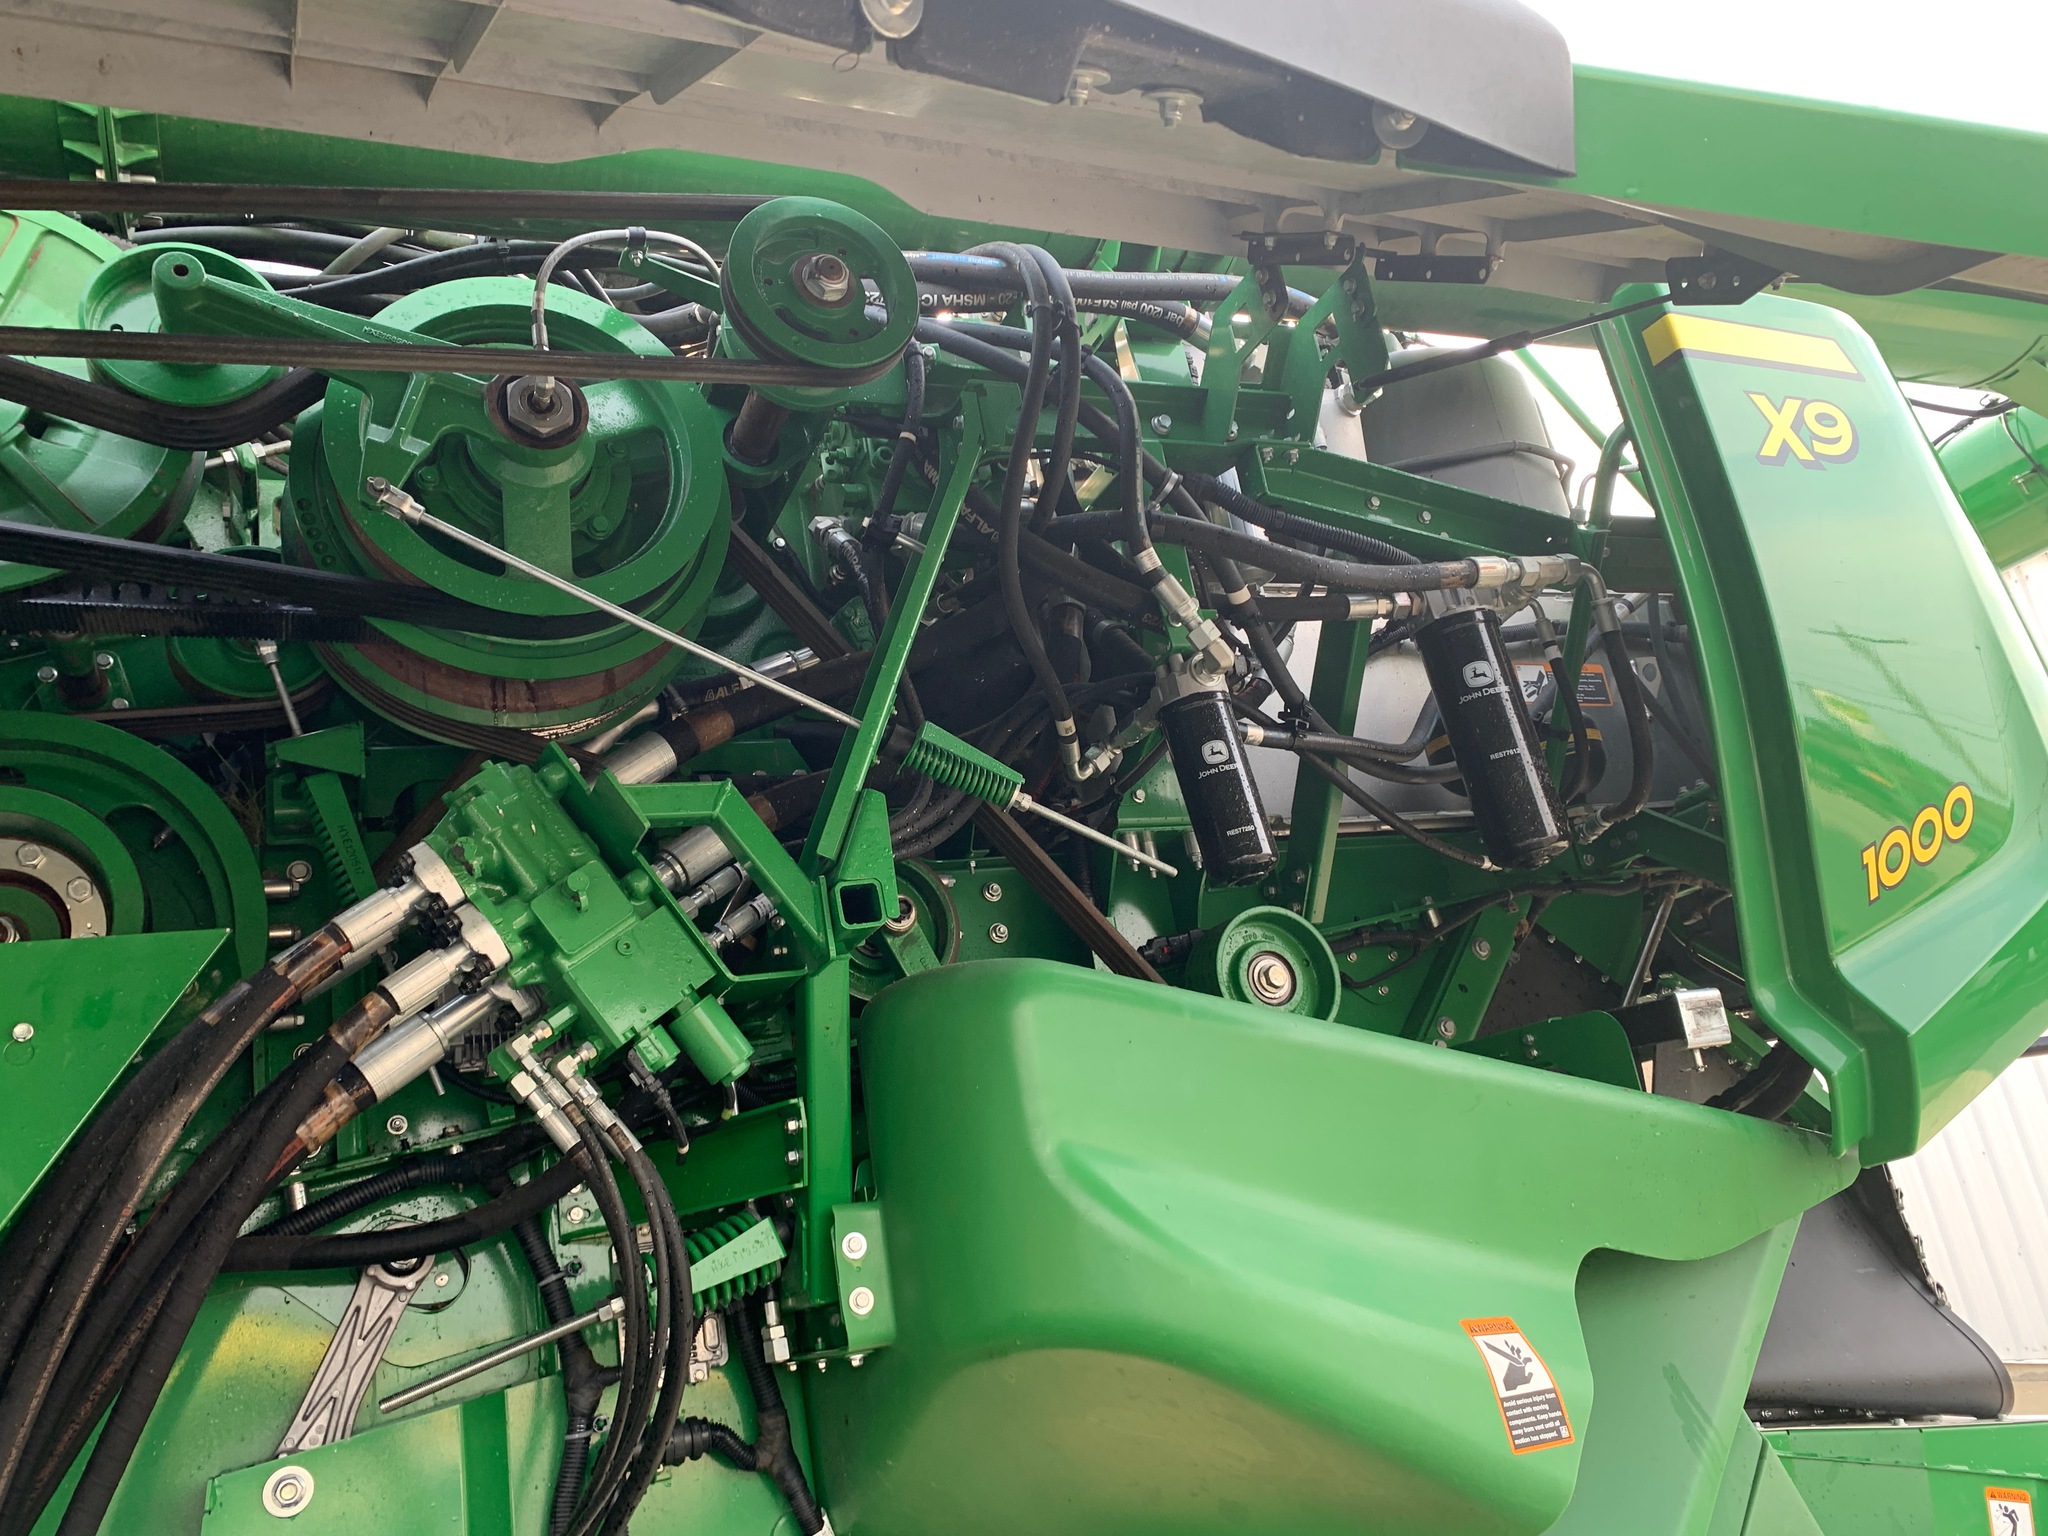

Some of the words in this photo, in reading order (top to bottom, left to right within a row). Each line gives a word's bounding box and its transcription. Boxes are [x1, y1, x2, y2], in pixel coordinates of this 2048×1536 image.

[941, 293, 987, 307] MSHA
[1120, 299, 1139, 311] psi)
[1140, 301, 1163, 318] (200
[1164, 308, 1185, 329] bar
[1743, 390, 1859, 471] X9
[1458, 690, 1482, 705] JOHN
[1482, 684, 1511, 697] DEERE
[1198, 766, 1220, 780] JOHN
[1219, 763, 1240, 773] DEER
[1861, 781, 1974, 906] 1000
[1475, 1321, 1515, 1333] WARNING
[1503, 1399, 1517, 1408] Avoid
[1516, 1397, 1533, 1406] serious
[1533, 1394, 1546, 1403] injury
[1545, 1392, 1557, 1400] from
[1506, 1408, 1523, 1417] contact
[1523, 1406, 1533, 1414] with
[1533, 1403, 1550, 1412] moving
[1508, 1416, 1538, 1427] components.
[1537, 1413, 1549, 1422] Keep
[1549, 1410, 1563, 1418] hands
[1511, 1427, 1524, 1436] away
[1524, 1425, 1535, 1433] from
[1535, 1423, 1545, 1431] vent
[1545, 1421, 1555, 1429] until
[1514, 1435, 1531, 1445] motion
[1531, 1433, 1540, 1442] has
[1539, 1430, 1559, 1440] stopped.
[1996, 1491, 2027, 1502] WARNING
